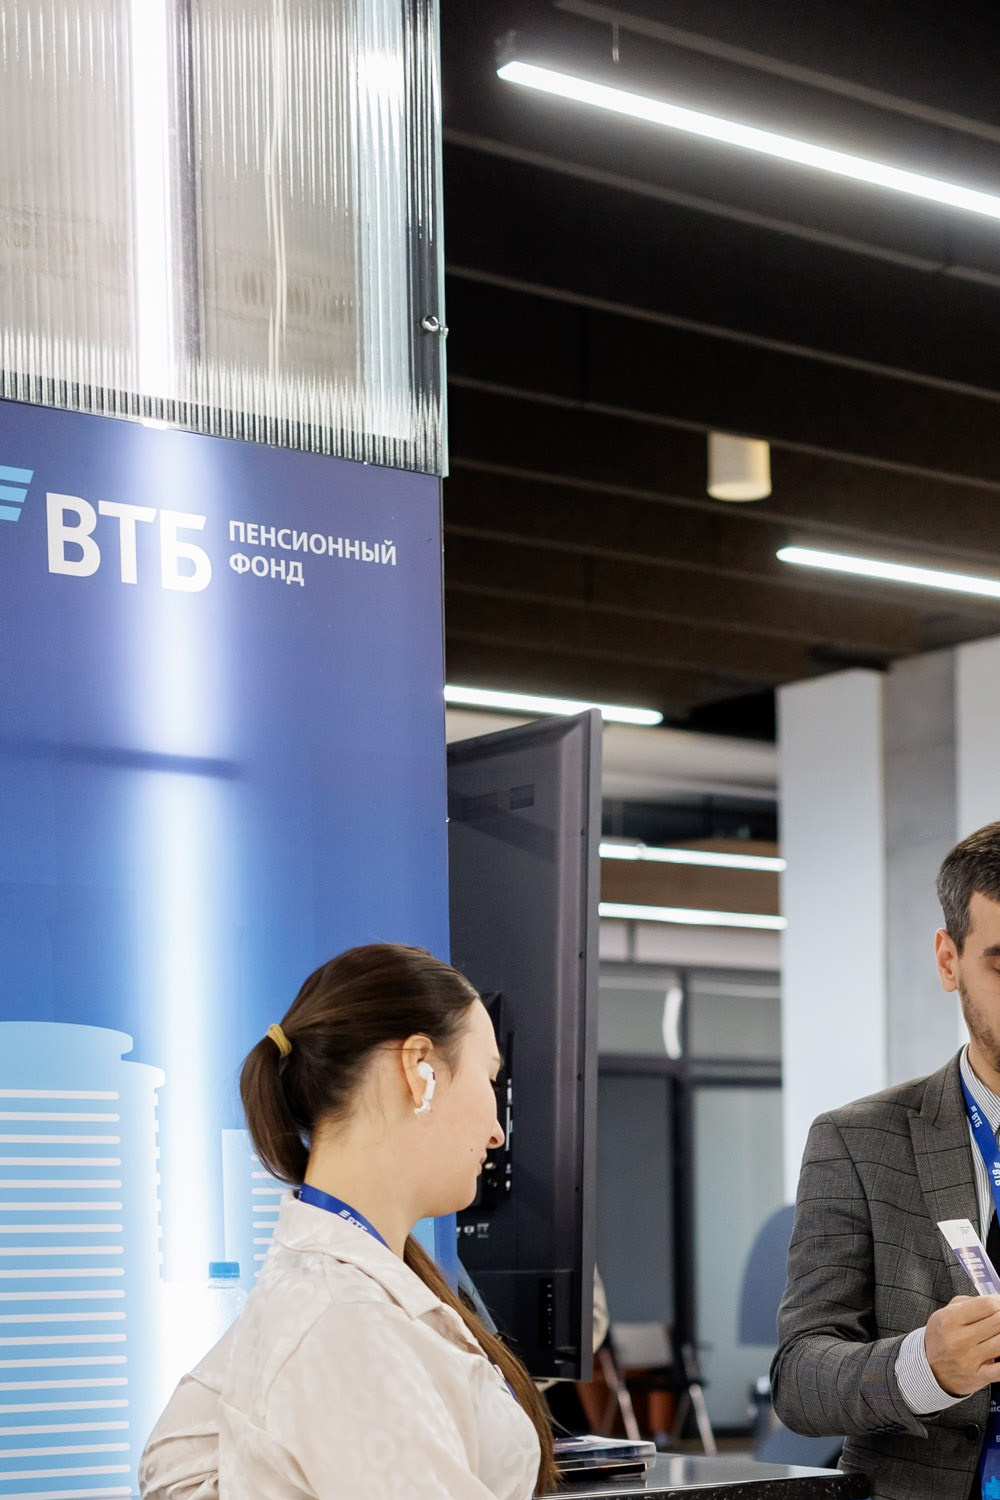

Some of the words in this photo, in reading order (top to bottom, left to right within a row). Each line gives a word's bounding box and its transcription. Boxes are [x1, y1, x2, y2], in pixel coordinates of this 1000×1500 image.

[46, 492, 212, 592] ВТБ
[229, 520, 397, 566] ПЕНСИОННЫЙ
[229, 553, 305, 587] ФОНД
[971, 1113, 983, 1129] ВТБ
